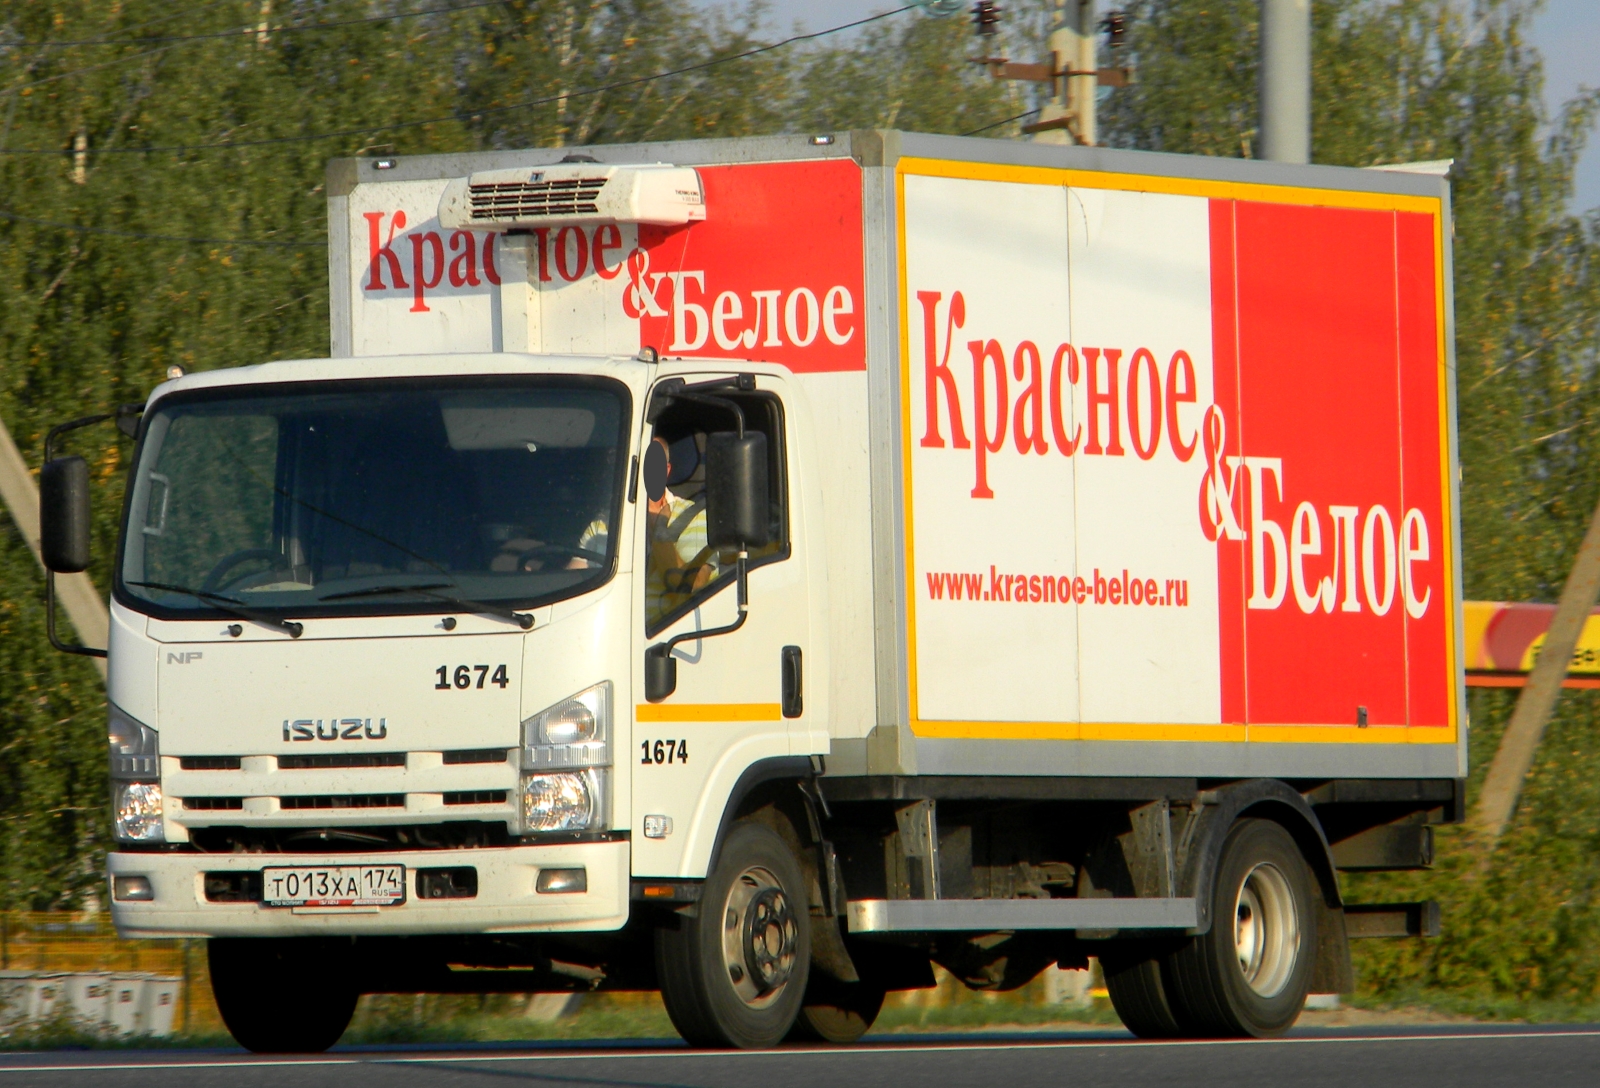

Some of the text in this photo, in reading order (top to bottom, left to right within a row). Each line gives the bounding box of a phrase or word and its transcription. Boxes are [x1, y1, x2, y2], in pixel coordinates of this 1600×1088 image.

[622, 247, 668, 319] &
[666, 270, 855, 352] Белое
[917, 290, 1431, 620] Красное & Белое
[926, 564, 1189, 607] www.krasnoe-beloe.ru
[435, 664, 509, 690] 1674
[282, 717, 388, 742] ISUZU
[641, 739, 688, 764] 1674
[364, 869, 397, 888] 174
[371, 888, 389, 897] RUS
